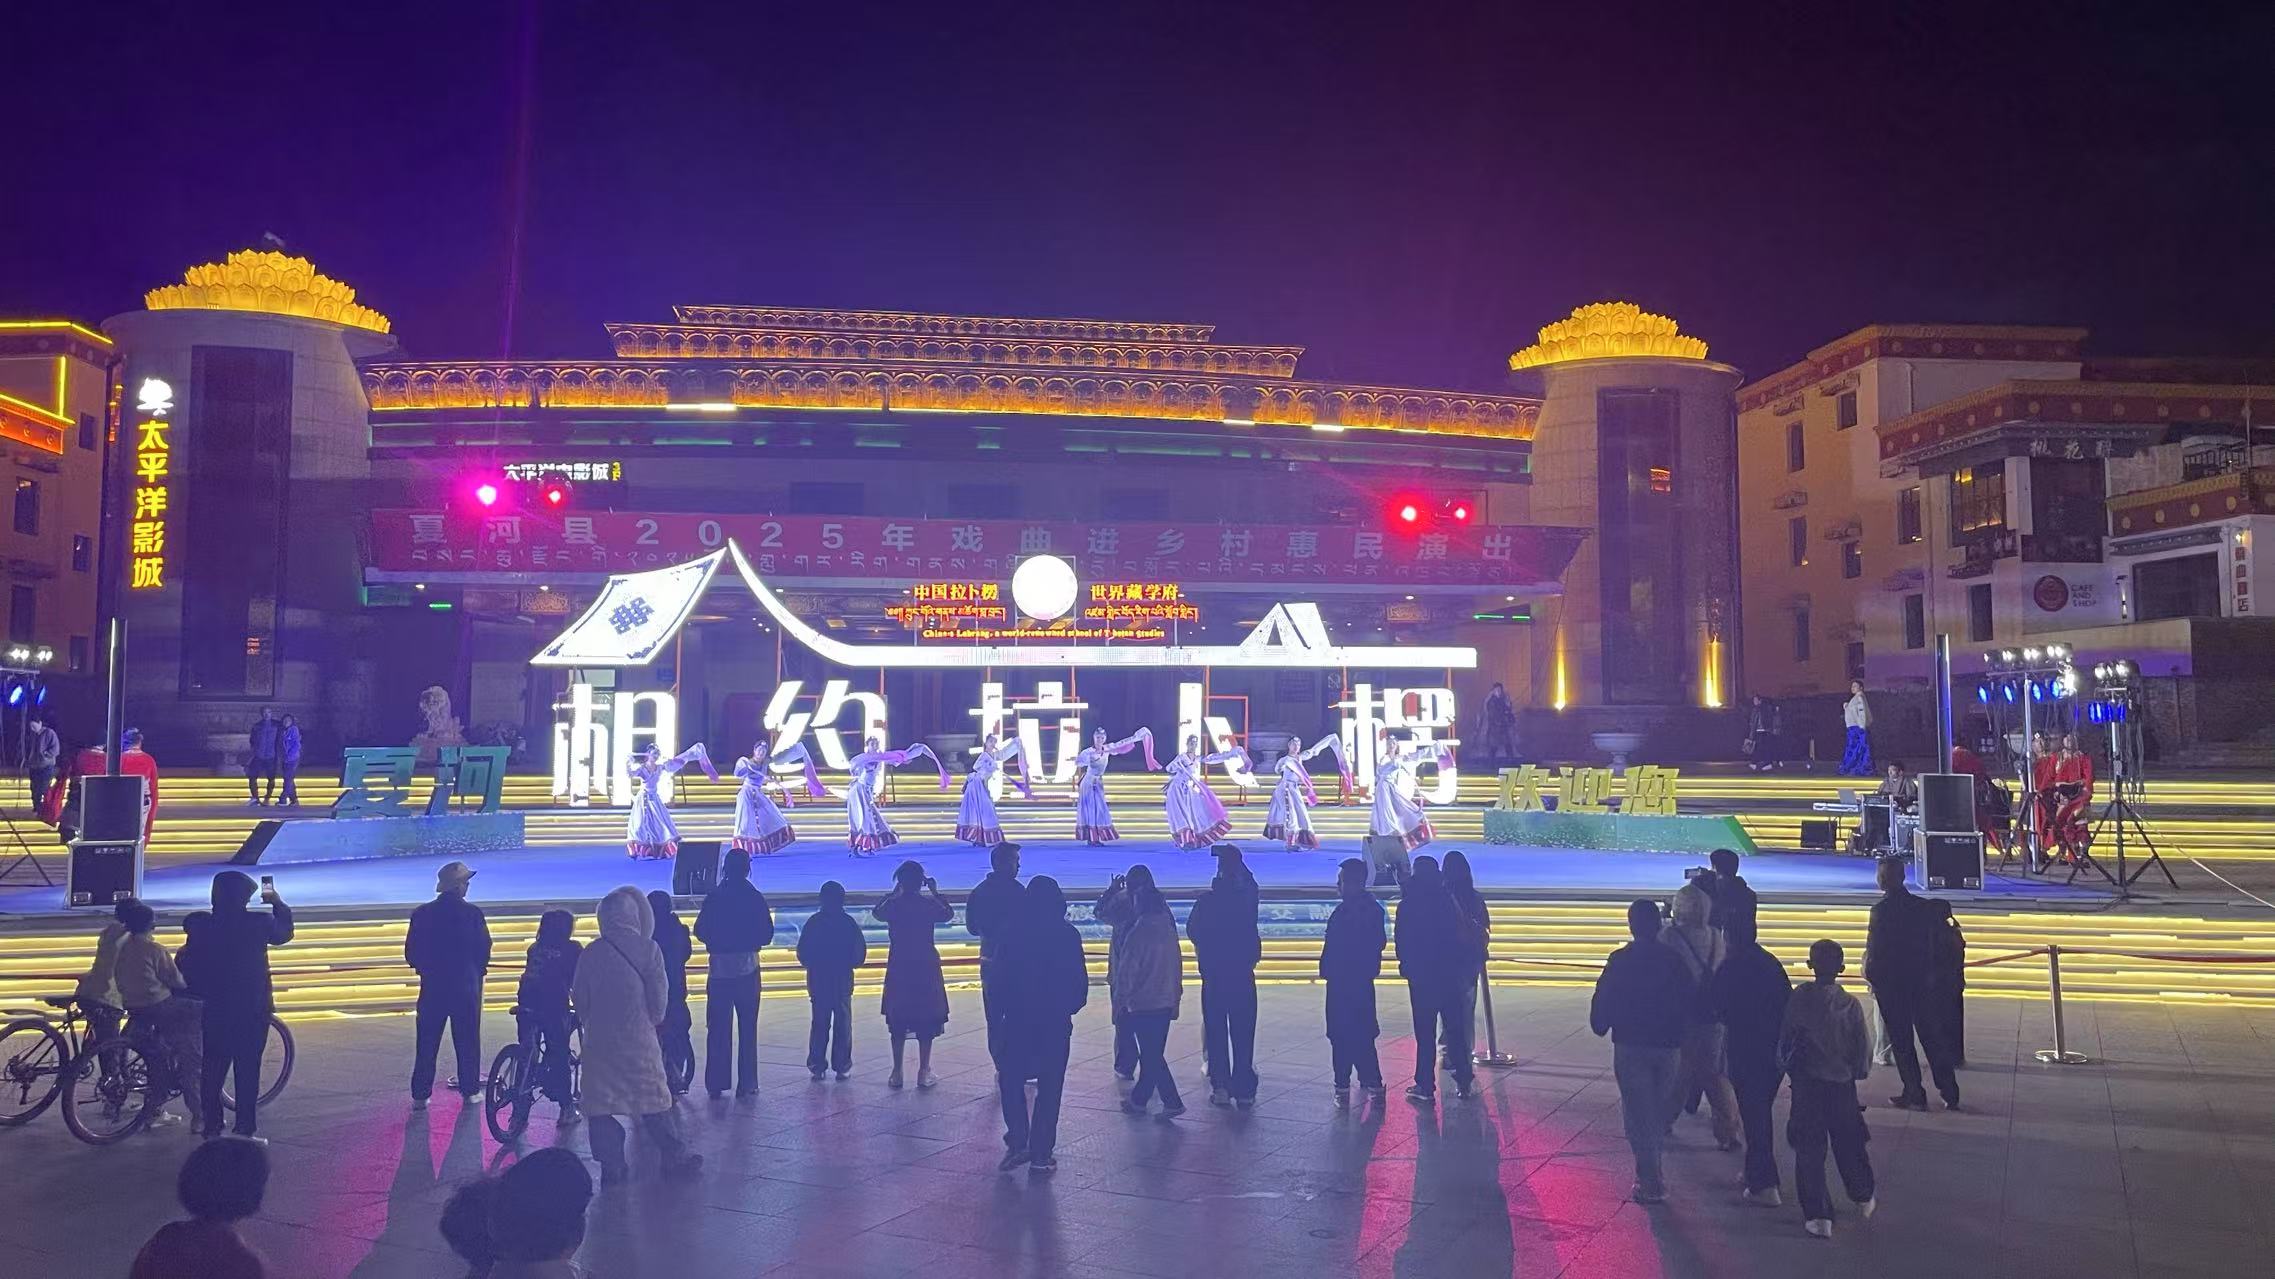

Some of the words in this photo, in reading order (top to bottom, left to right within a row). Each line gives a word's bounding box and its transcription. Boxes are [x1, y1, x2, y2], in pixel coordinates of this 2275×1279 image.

[132, 420, 169, 588] 太平洋影城
[409, 514, 1512, 562] 夏河县2025年戏曲进乡村惠民演出
[914, 583, 999, 601] 中国拉卜楞
[1090, 583, 1178, 601] 世界藏学府
[1104, 628, 1134, 638] Tbetan
[334, 746, 512, 819] 夏河
[1494, 764, 1679, 816] 欢迎您
